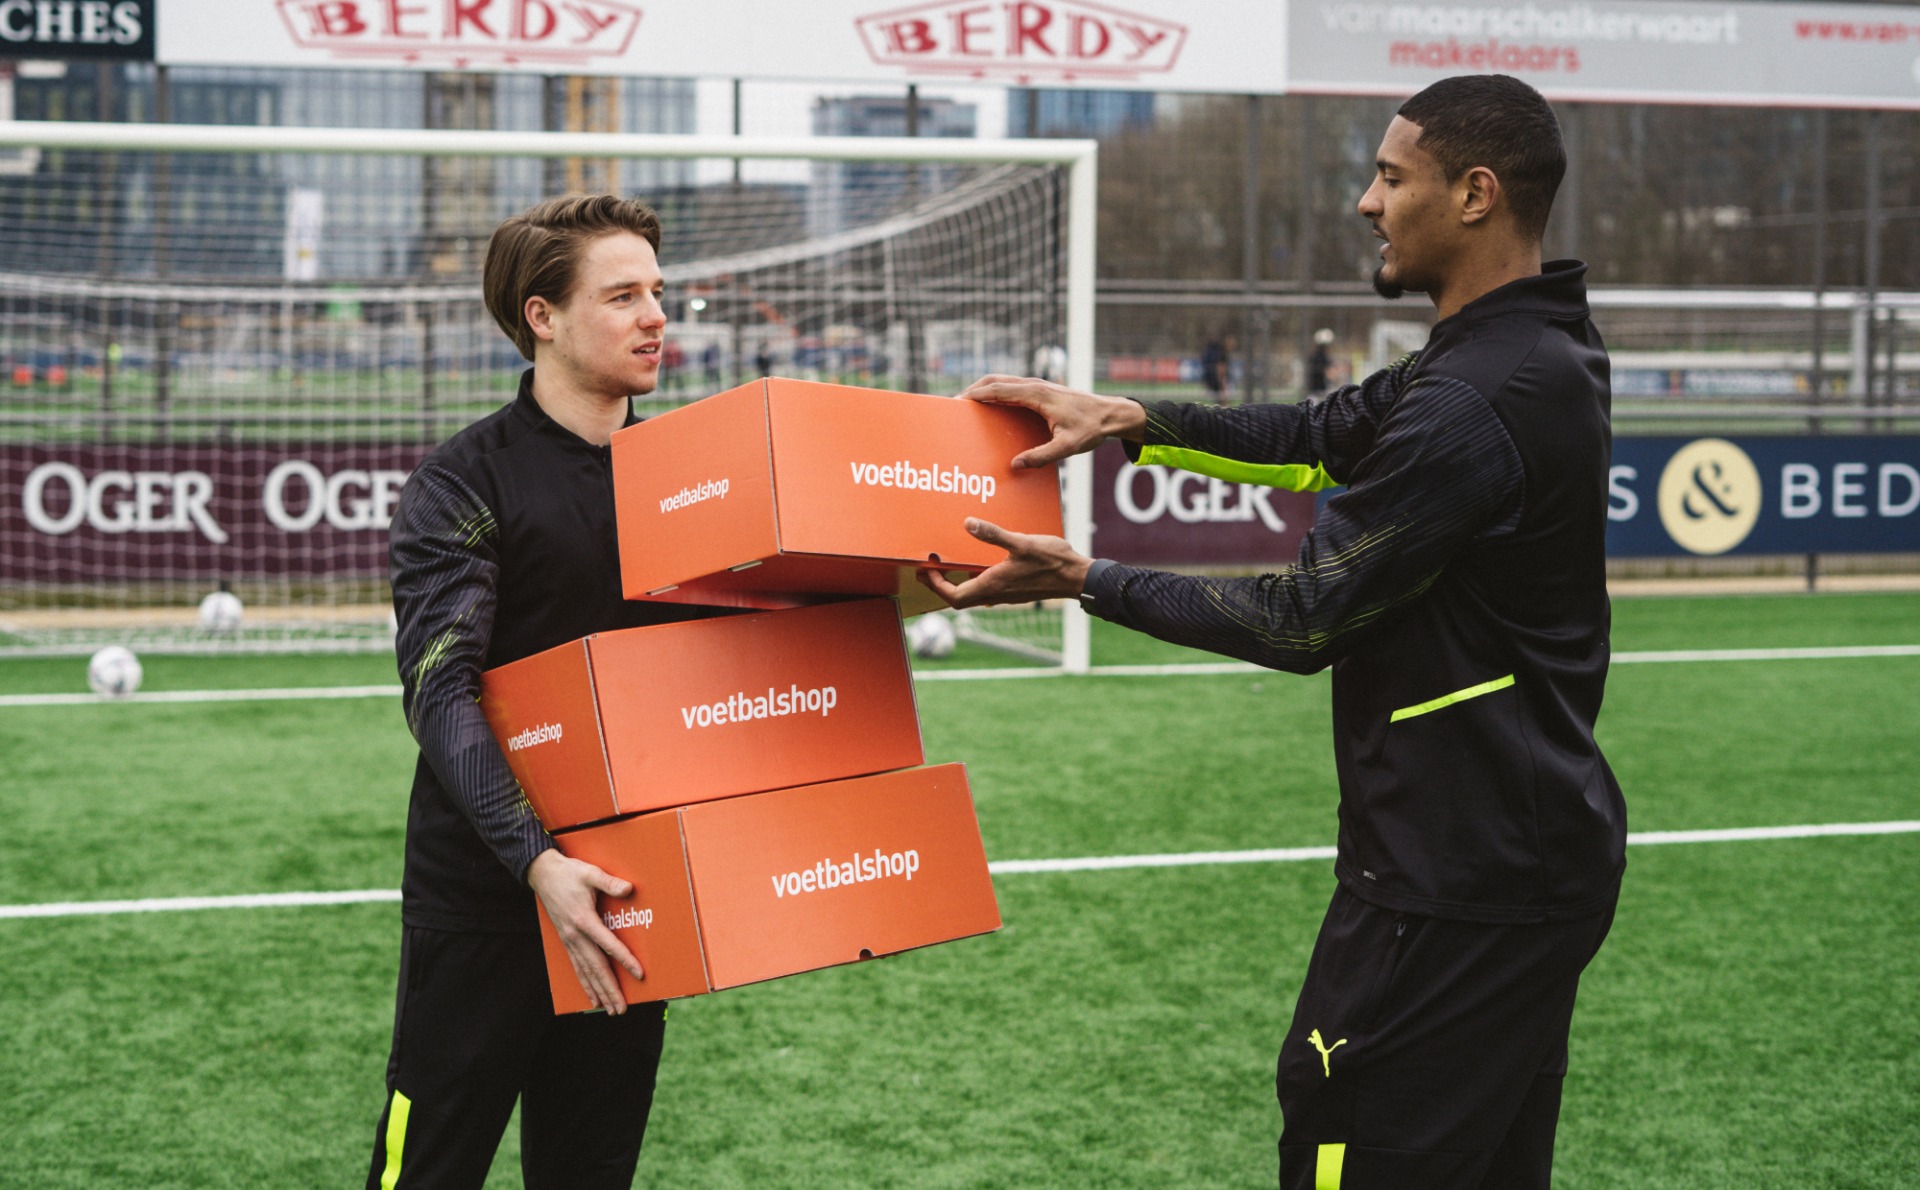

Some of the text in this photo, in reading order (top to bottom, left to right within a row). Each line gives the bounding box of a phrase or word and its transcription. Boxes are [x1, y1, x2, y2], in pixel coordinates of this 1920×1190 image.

[0, 0, 143, 45] CHES
[301, 0, 617, 43] BERDY
[877, 0, 1167, 61] BERDY
[1388, 36, 1581, 74] makelaars
[262, 459, 412, 533] OGE
[659, 478, 730, 514] voetbalshop
[851, 460, 996, 504] voetbalshop
[1780, 462, 1920, 519] BED
[681, 684, 837, 730] voetbalshop
[507, 722, 563, 752] voetbalshop
[771, 848, 920, 899] voetbalshop
[603, 906, 653, 931] tbalshop
